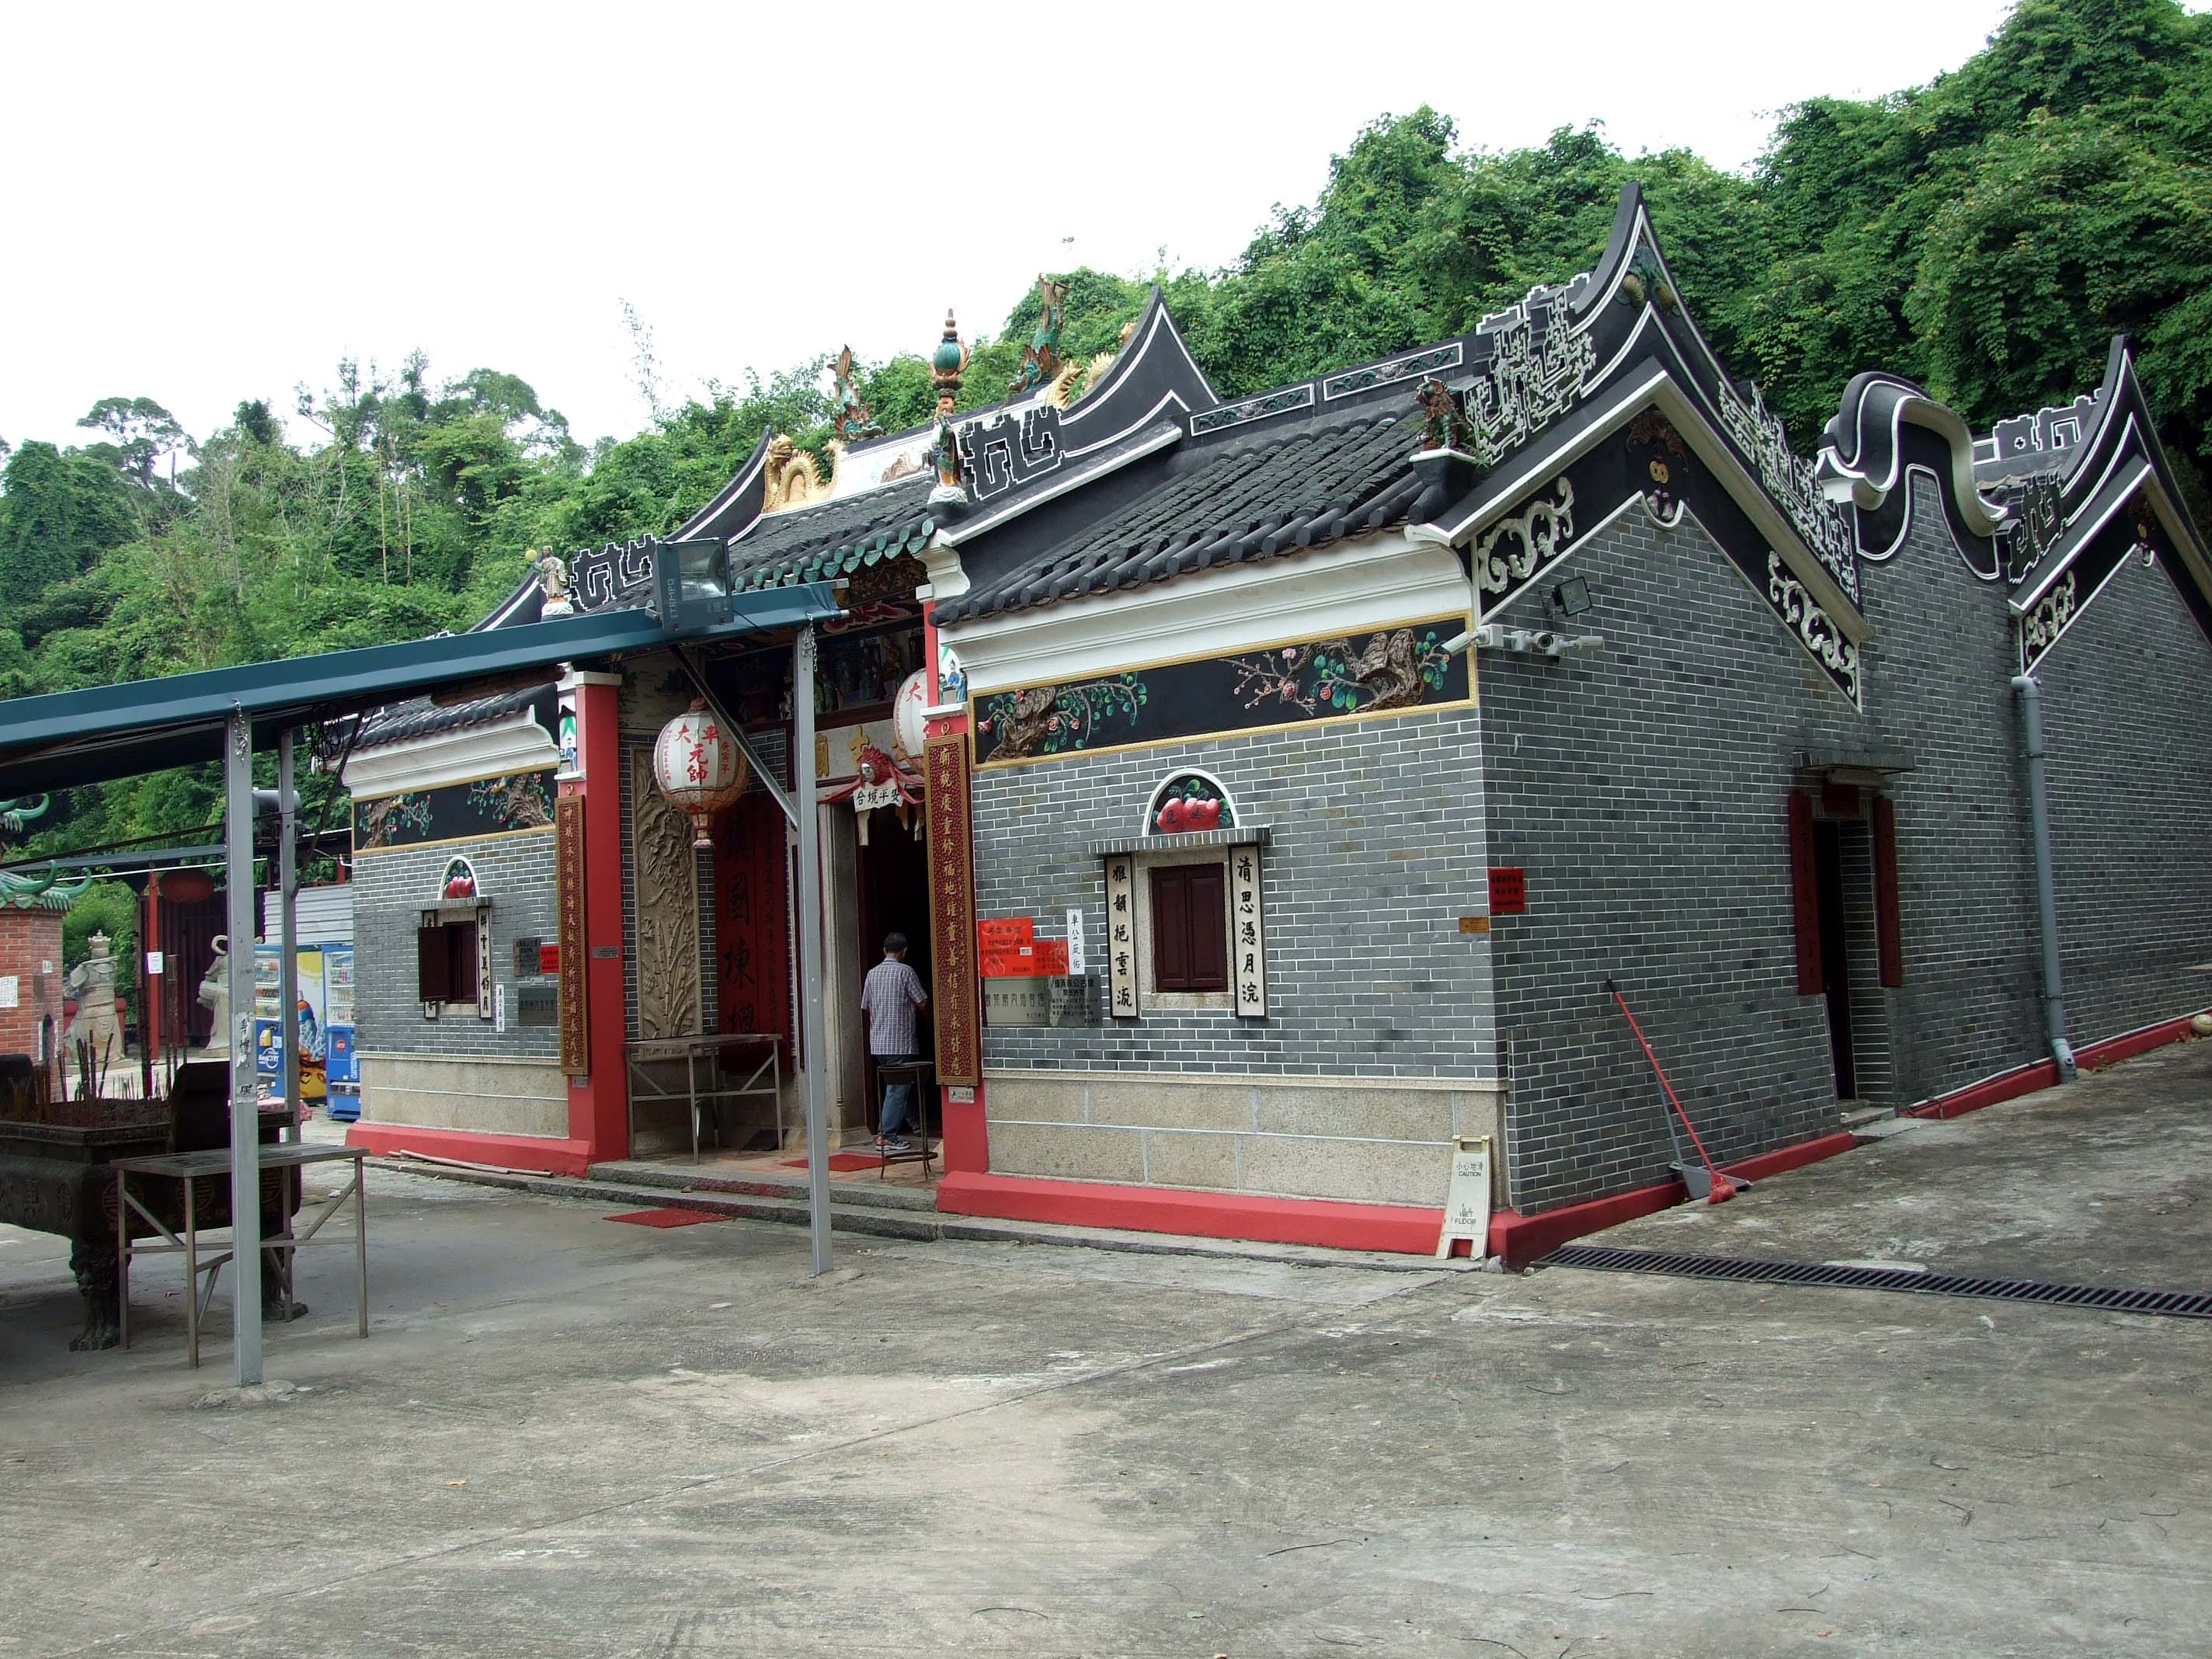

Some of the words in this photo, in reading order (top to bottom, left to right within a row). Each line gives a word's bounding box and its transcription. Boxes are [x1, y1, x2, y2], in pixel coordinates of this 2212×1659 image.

[857, 788, 900, 805] 合境平安
[1071, 914, 1080, 969] 車公庇佑
